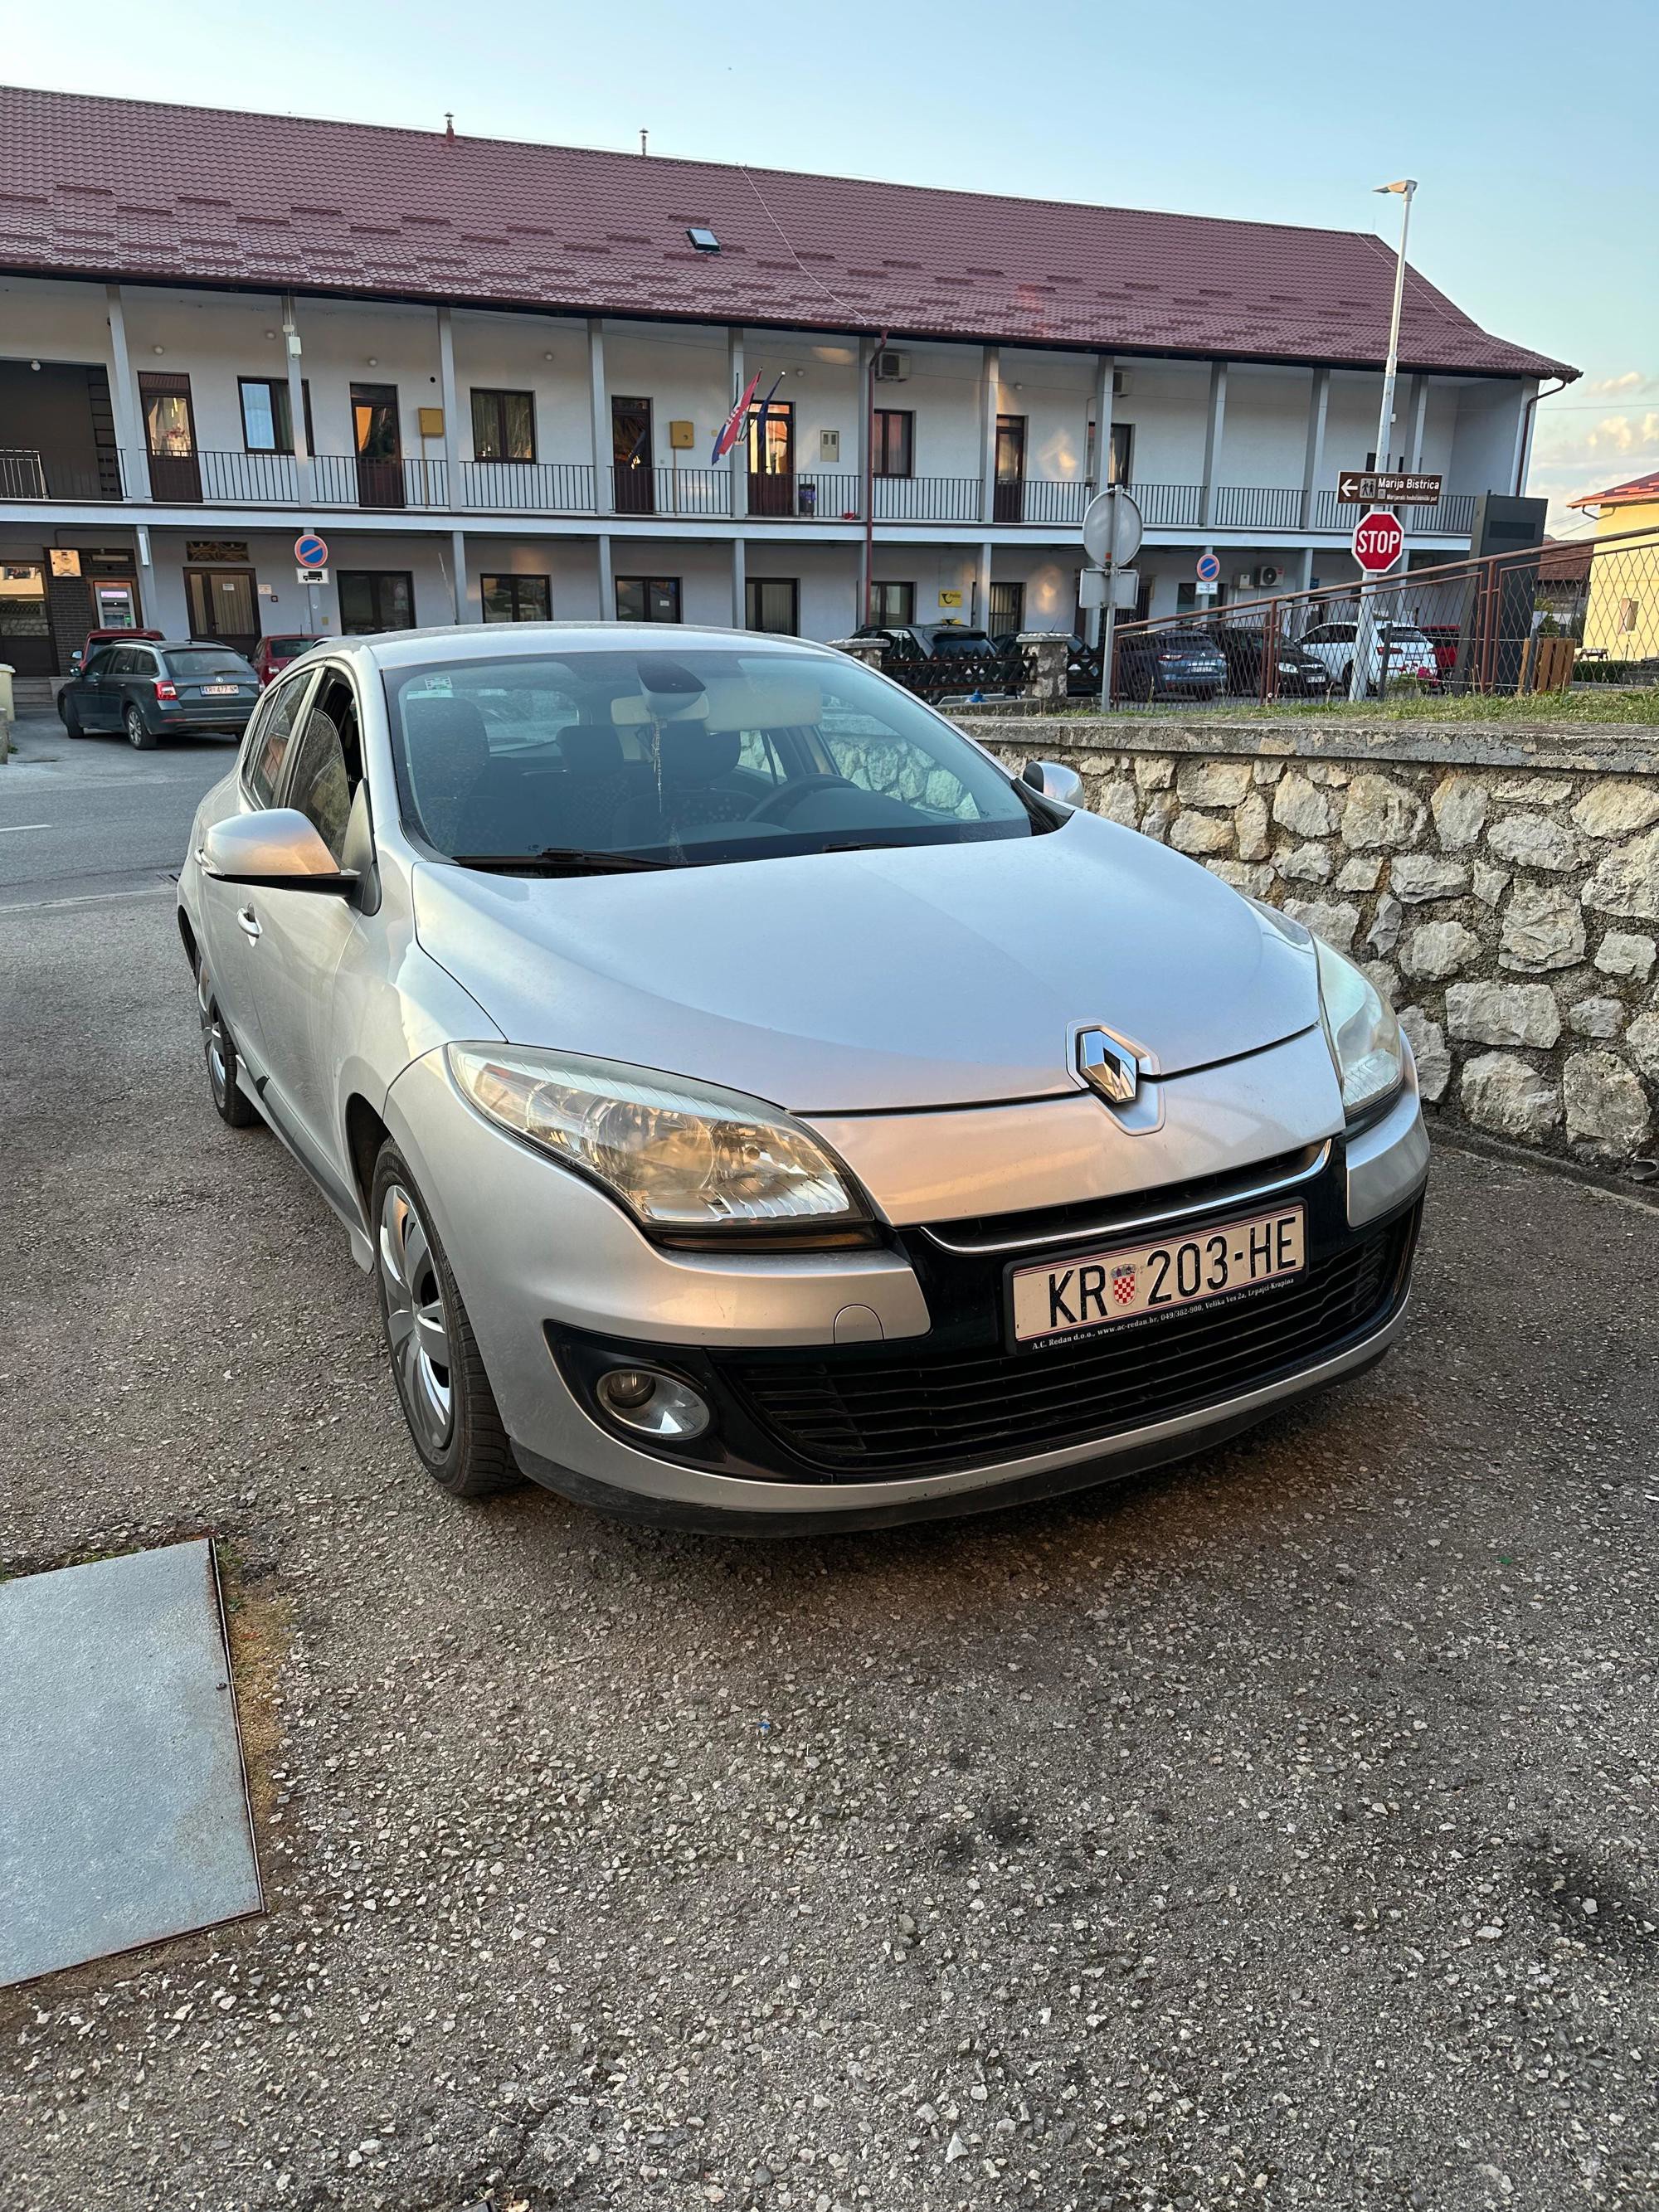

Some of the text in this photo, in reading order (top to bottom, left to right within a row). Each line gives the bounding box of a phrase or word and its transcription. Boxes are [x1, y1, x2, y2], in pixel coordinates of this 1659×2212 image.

[1378, 477, 1440, 491] Marija Bistrica
[1357, 529, 1400, 554] STOP
[1048, 1216, 1297, 1328] KR 203-HE
[1032, 1340, 1047, 1350] A.C.
[1048, 1336, 1072, 1347] Redan
[1097, 1317, 1160, 1335] www.ac-redan.hr,
[1205, 1299, 1225, 1310] Velika
[1226, 1296, 1237, 1304] Ves
